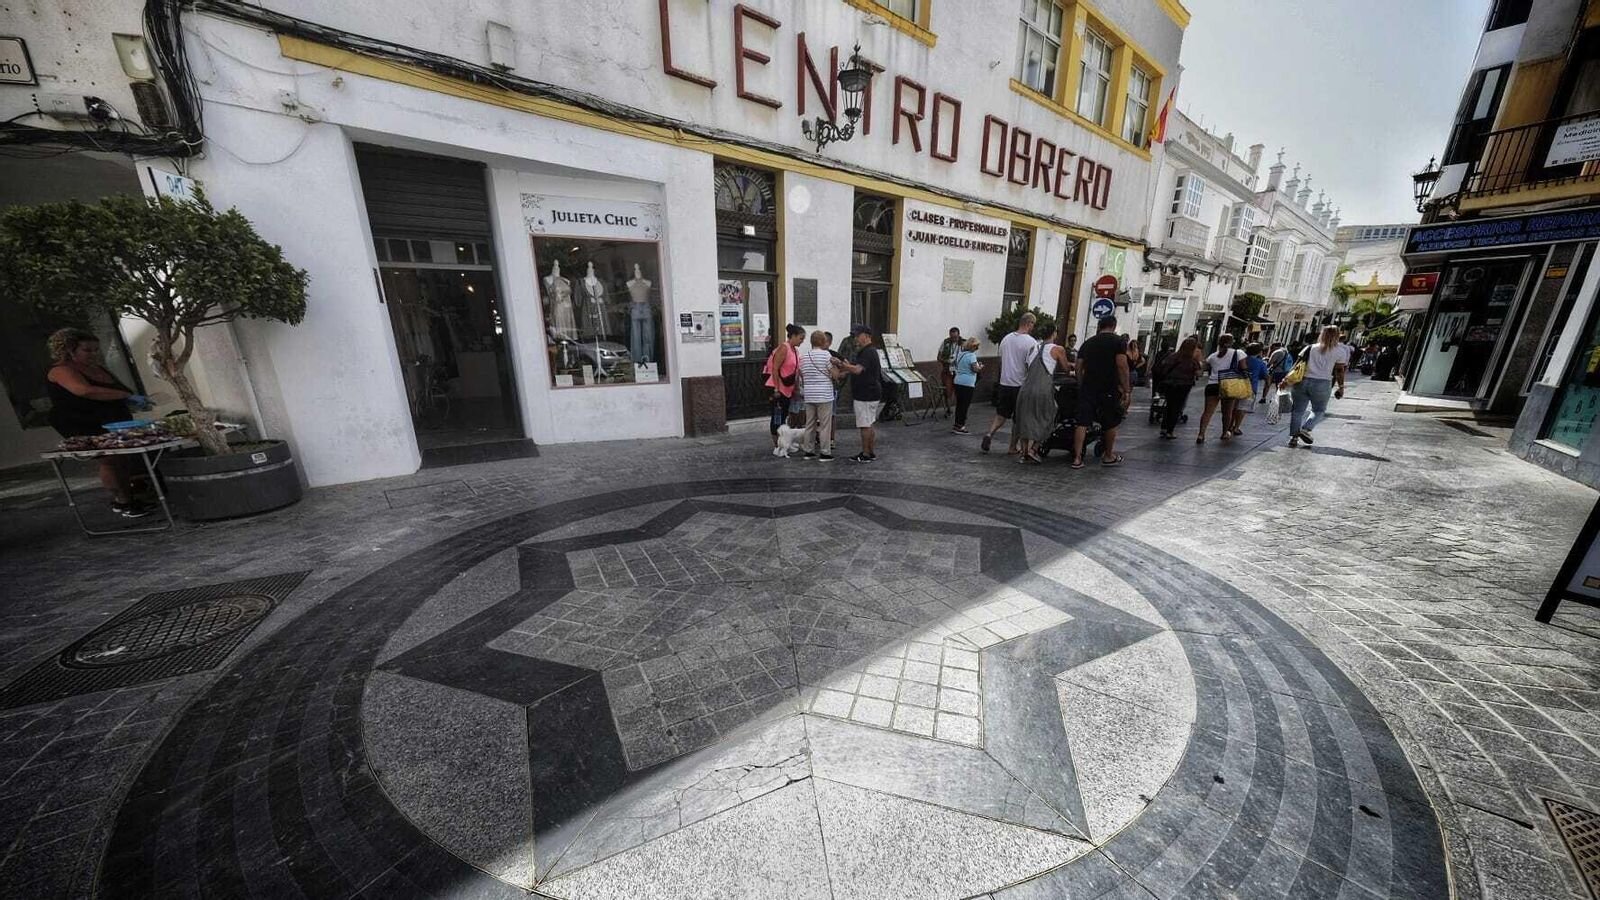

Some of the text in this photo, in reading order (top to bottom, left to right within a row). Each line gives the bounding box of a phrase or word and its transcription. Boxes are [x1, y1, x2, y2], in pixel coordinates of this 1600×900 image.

[658, 0, 1113, 211] CENTRO OBRERO
[911, 210, 1007, 237] CLASES PROFESIONALES
[1411, 220, 1522, 243] ACCESORIOS
[912, 231, 937, 244] JUAN
[938, 235, 970, 249] COELLO
